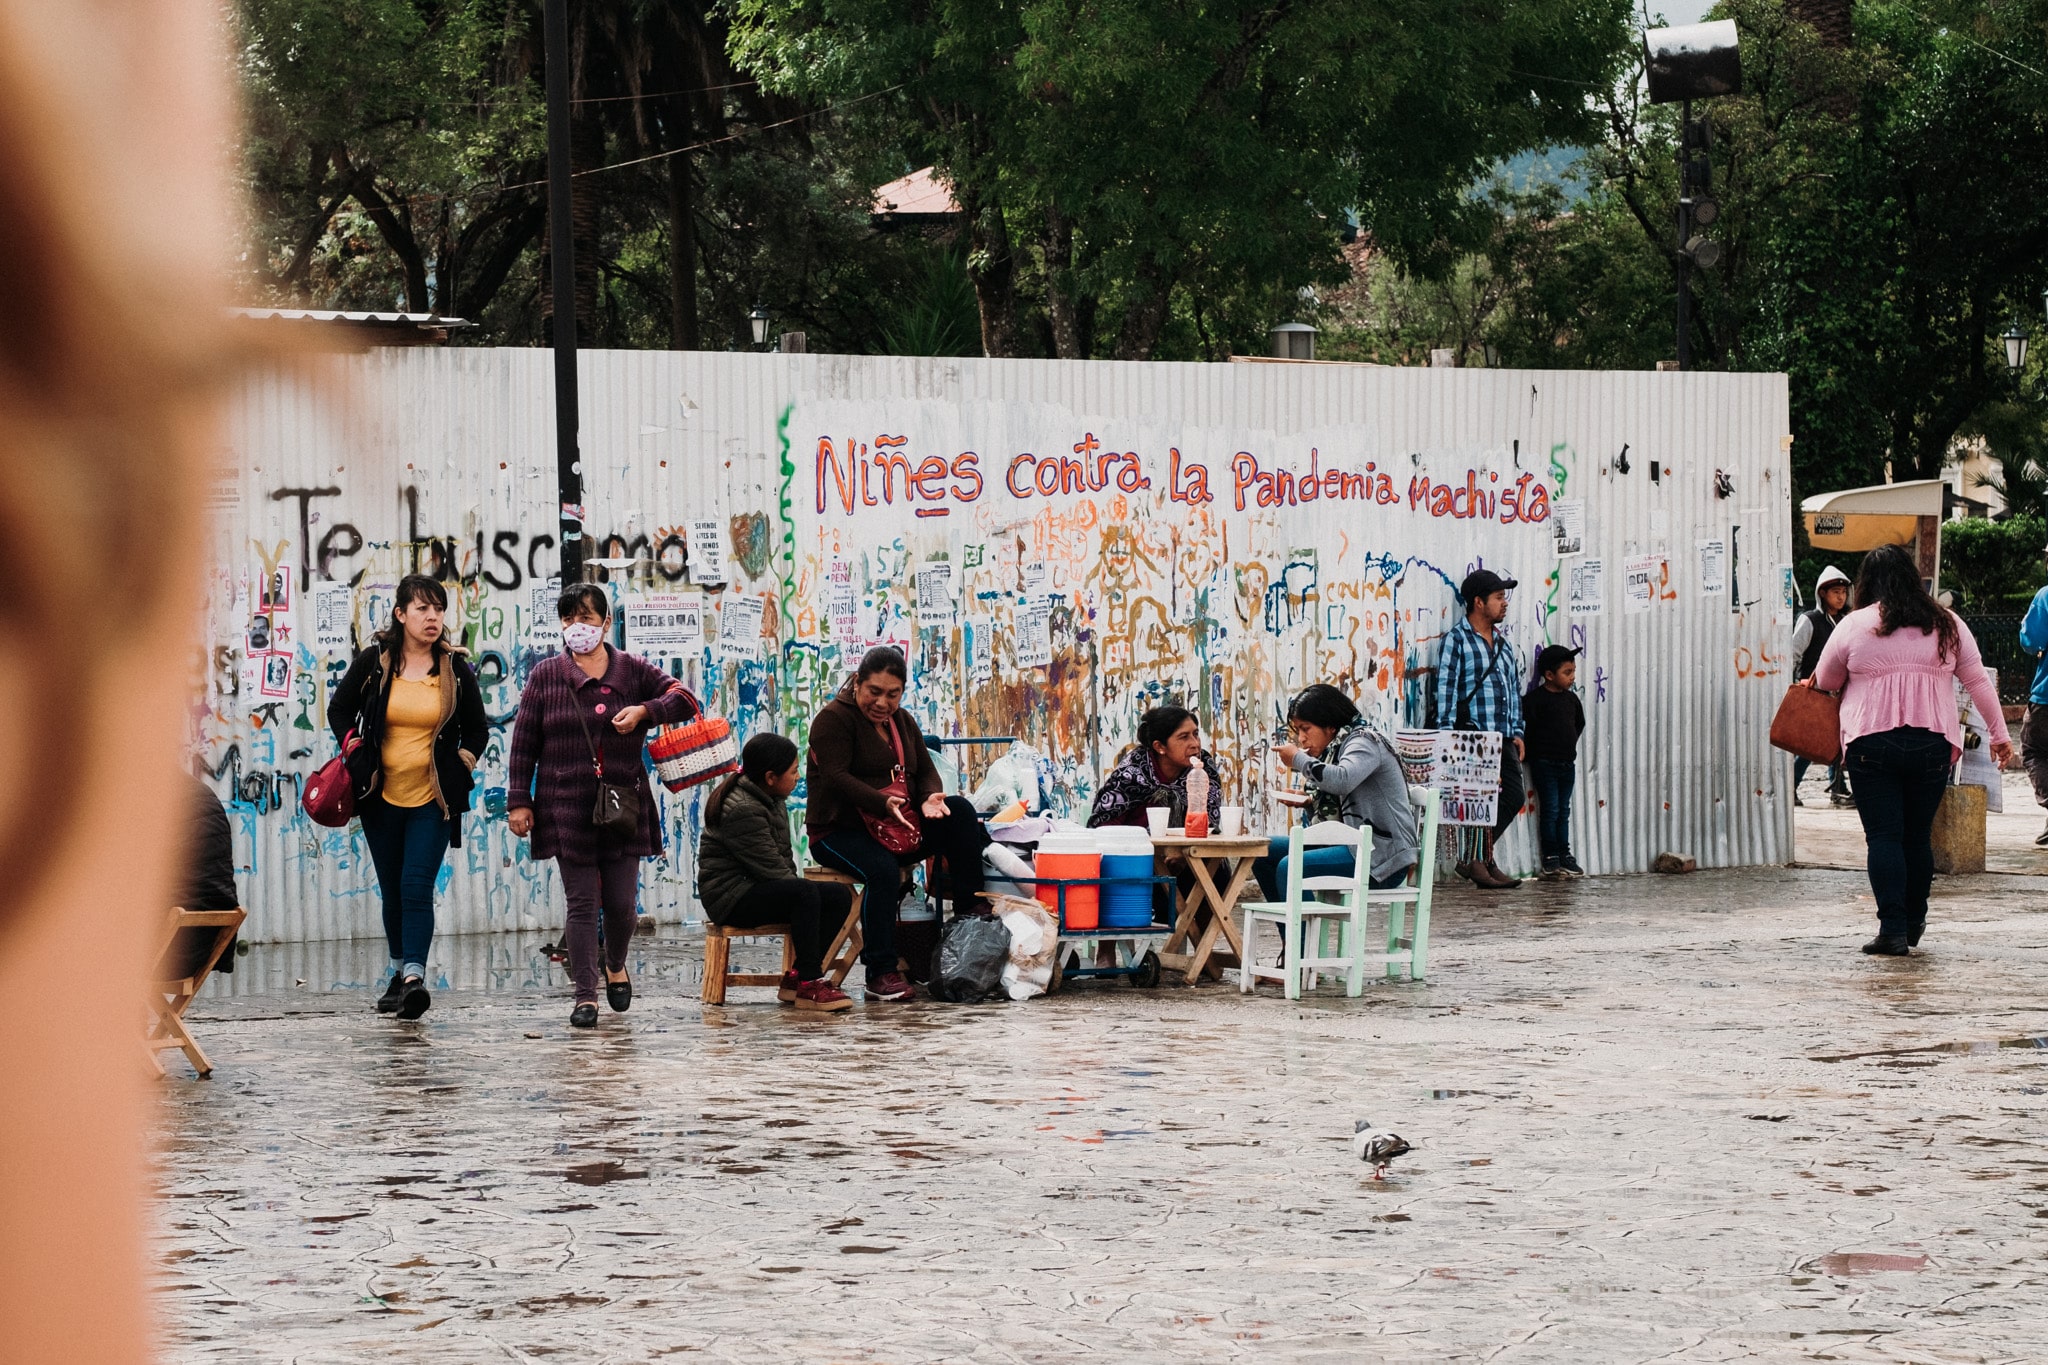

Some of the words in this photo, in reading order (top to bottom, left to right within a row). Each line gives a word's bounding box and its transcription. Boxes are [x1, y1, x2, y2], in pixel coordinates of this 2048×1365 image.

[816, 433, 984, 517] Niñes
[1232, 446, 1400, 511] Pandemia
[1410, 468, 1550, 523] Machista
[267, 484, 366, 594] Te
